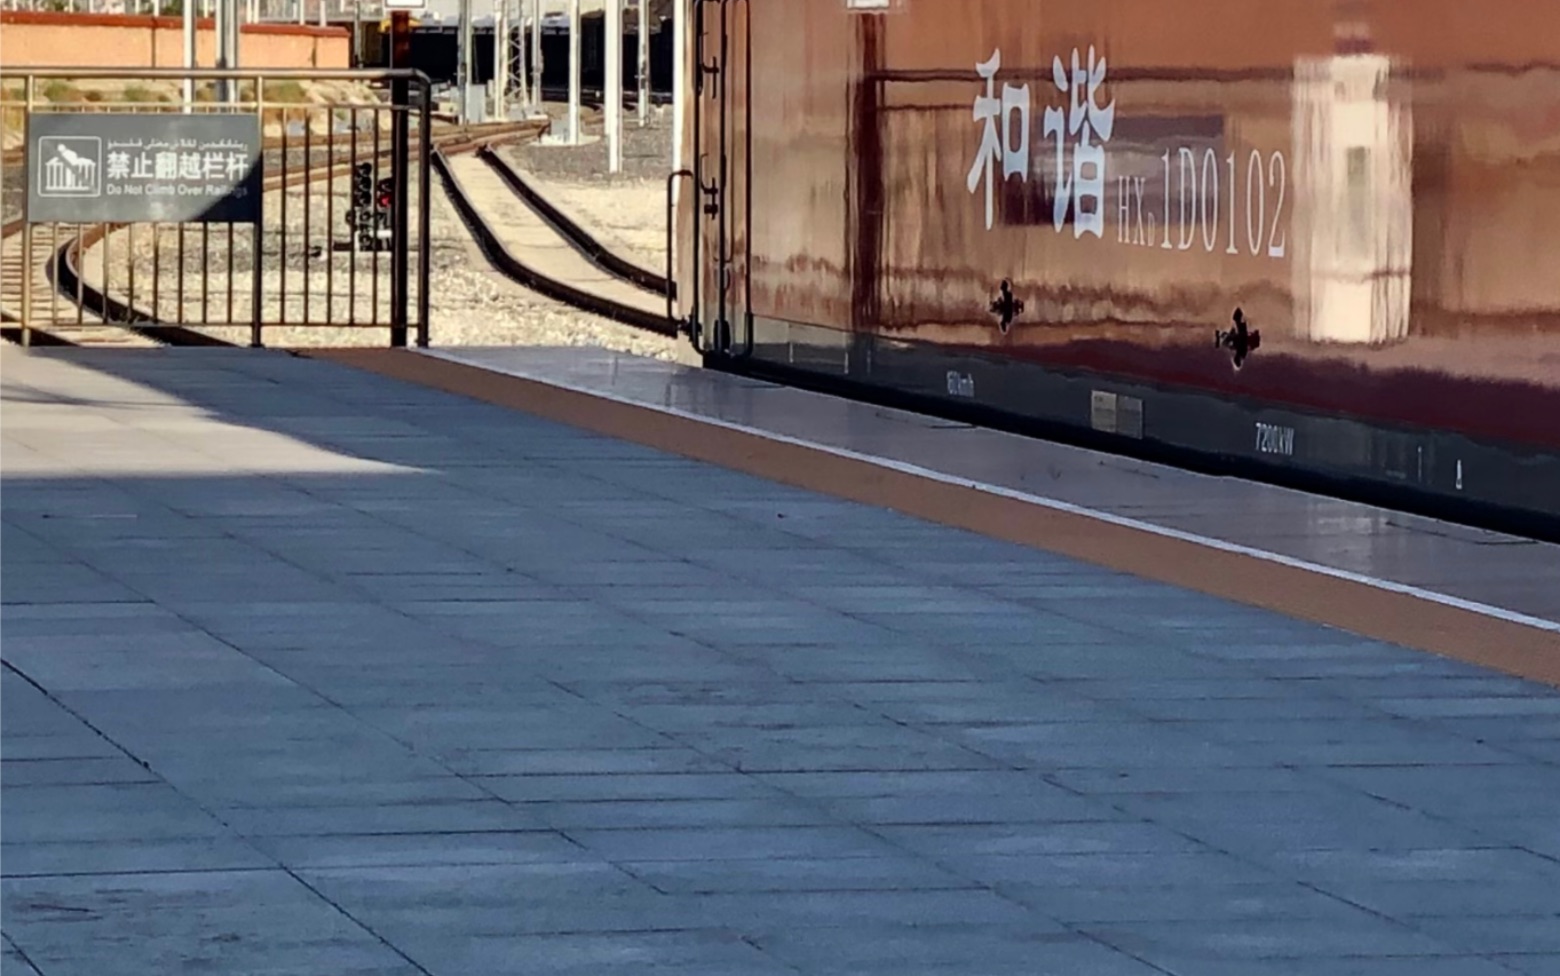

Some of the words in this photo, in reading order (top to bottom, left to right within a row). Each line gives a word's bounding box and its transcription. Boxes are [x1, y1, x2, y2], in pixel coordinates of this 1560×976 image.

[966, 44, 1116, 239] 和谐
[107, 151, 249, 181] 禁止翻越栏杆
[106, 184, 122, 195] Do
[124, 184, 143, 195] Not
[177, 184, 204, 195] Over
